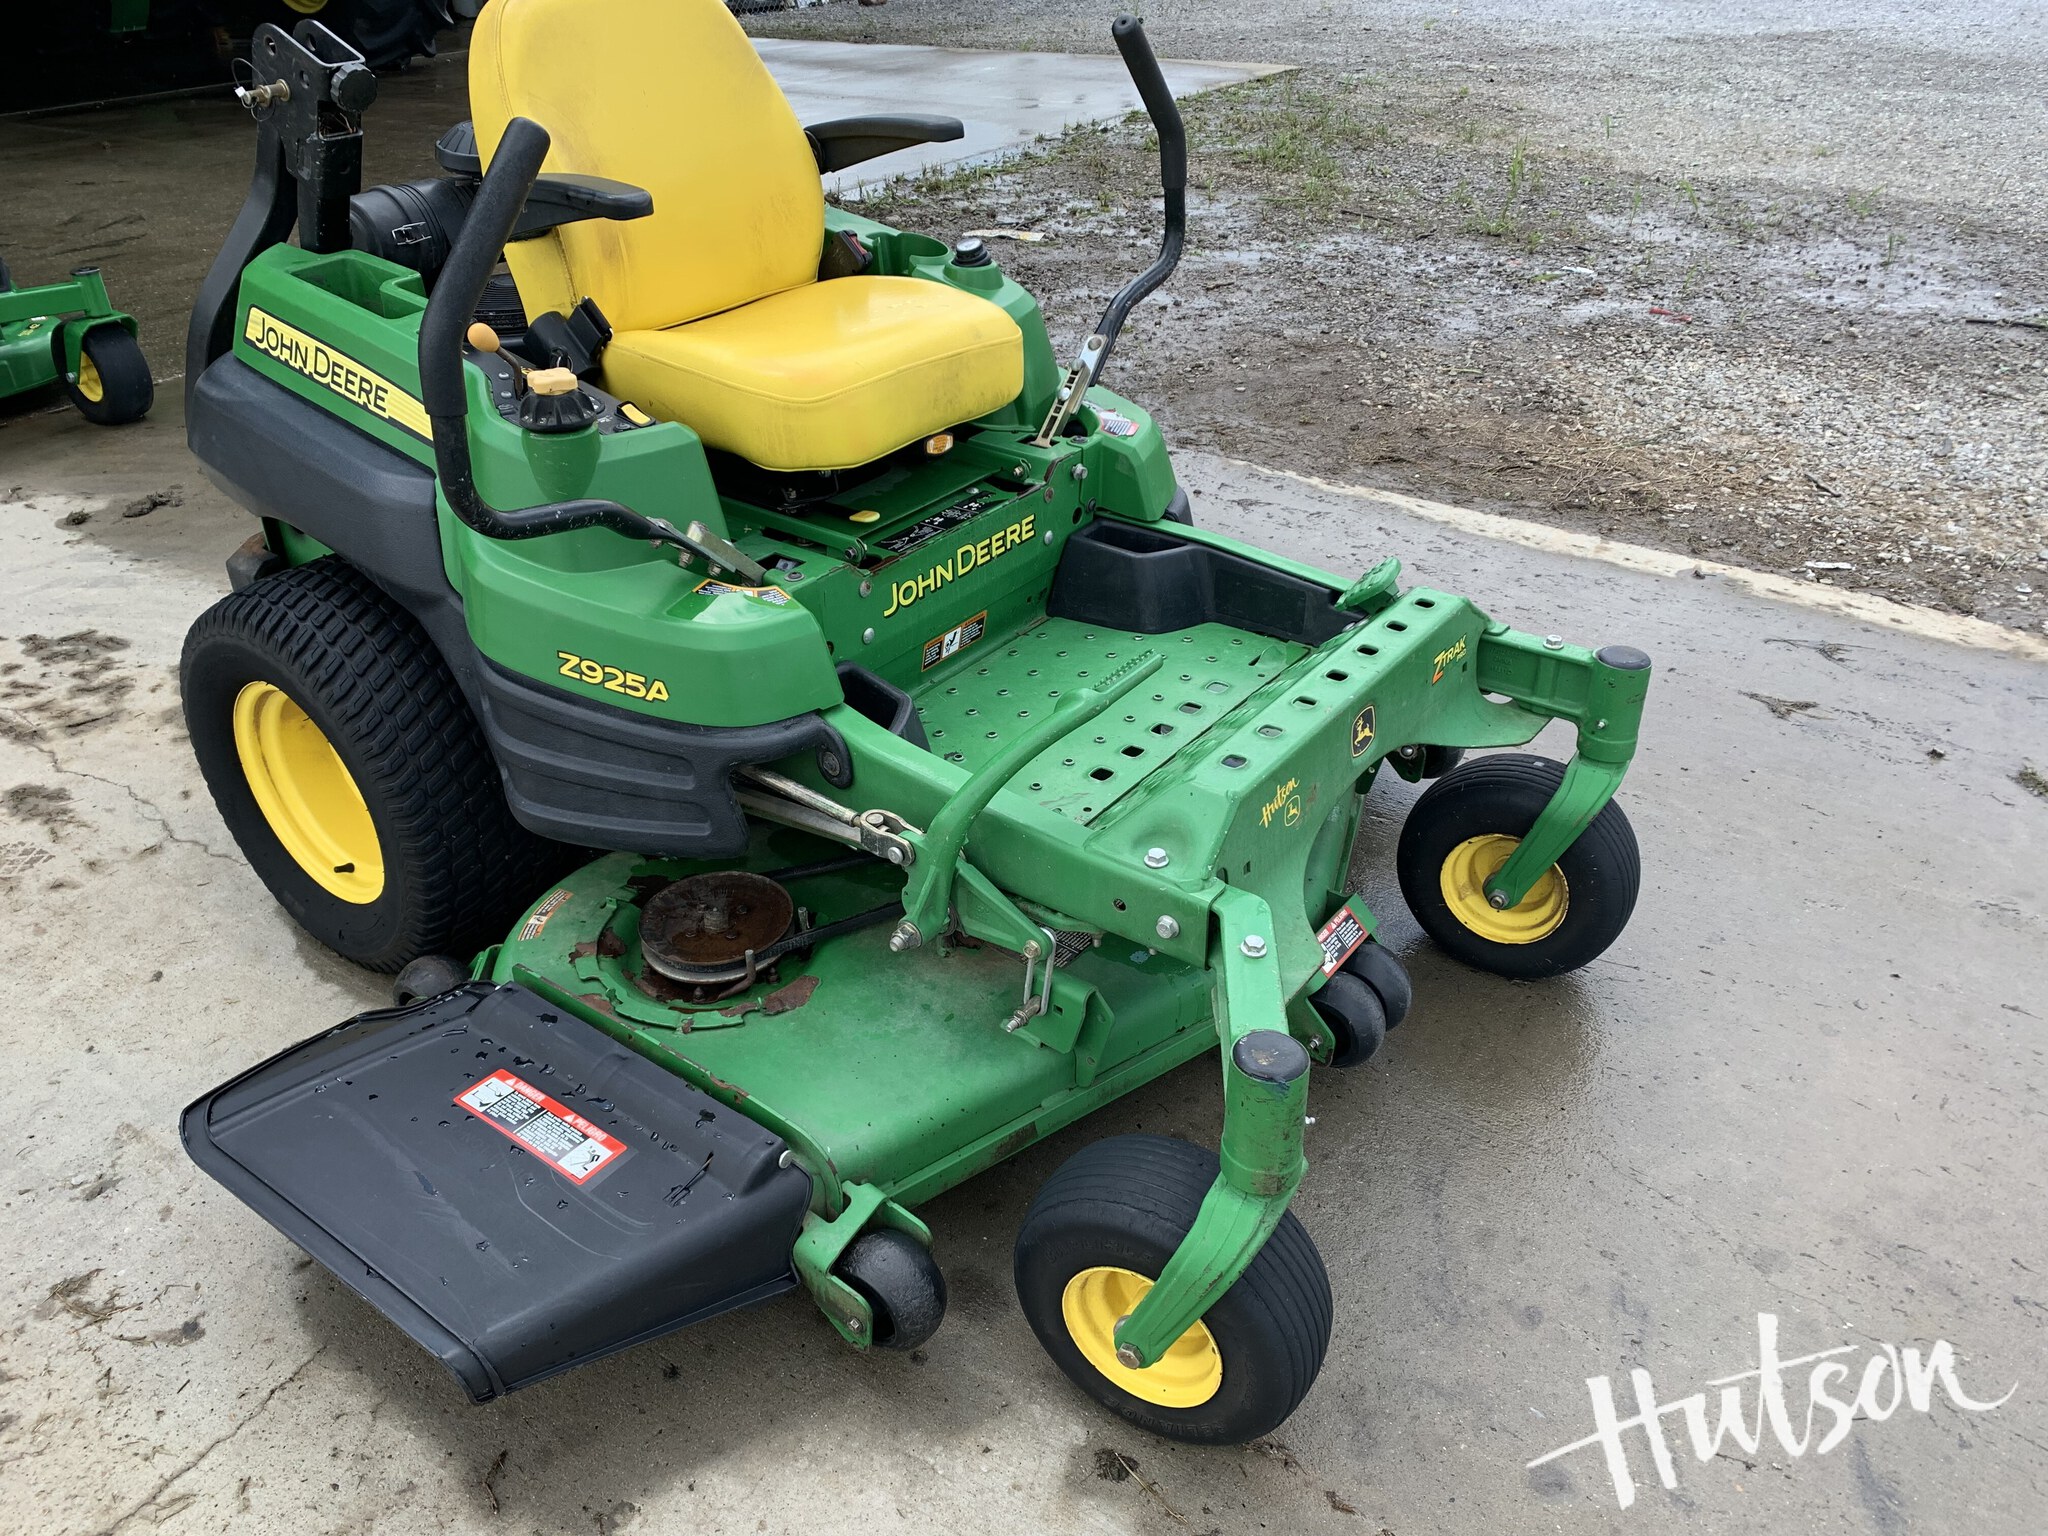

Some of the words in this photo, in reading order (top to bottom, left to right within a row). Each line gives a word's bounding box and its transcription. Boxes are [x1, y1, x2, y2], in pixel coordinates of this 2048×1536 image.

[255, 317, 309, 370] JOHN
[313, 345, 390, 414] DEERE
[883, 558, 954, 618] JOHN
[956, 513, 1036, 577] DEERE
[557, 650, 670, 702] Z925A
[1259, 777, 1300, 829] Hutson
[513, 1080, 546, 1103] DANGER
[572, 1117, 609, 1142] PELIGRO
